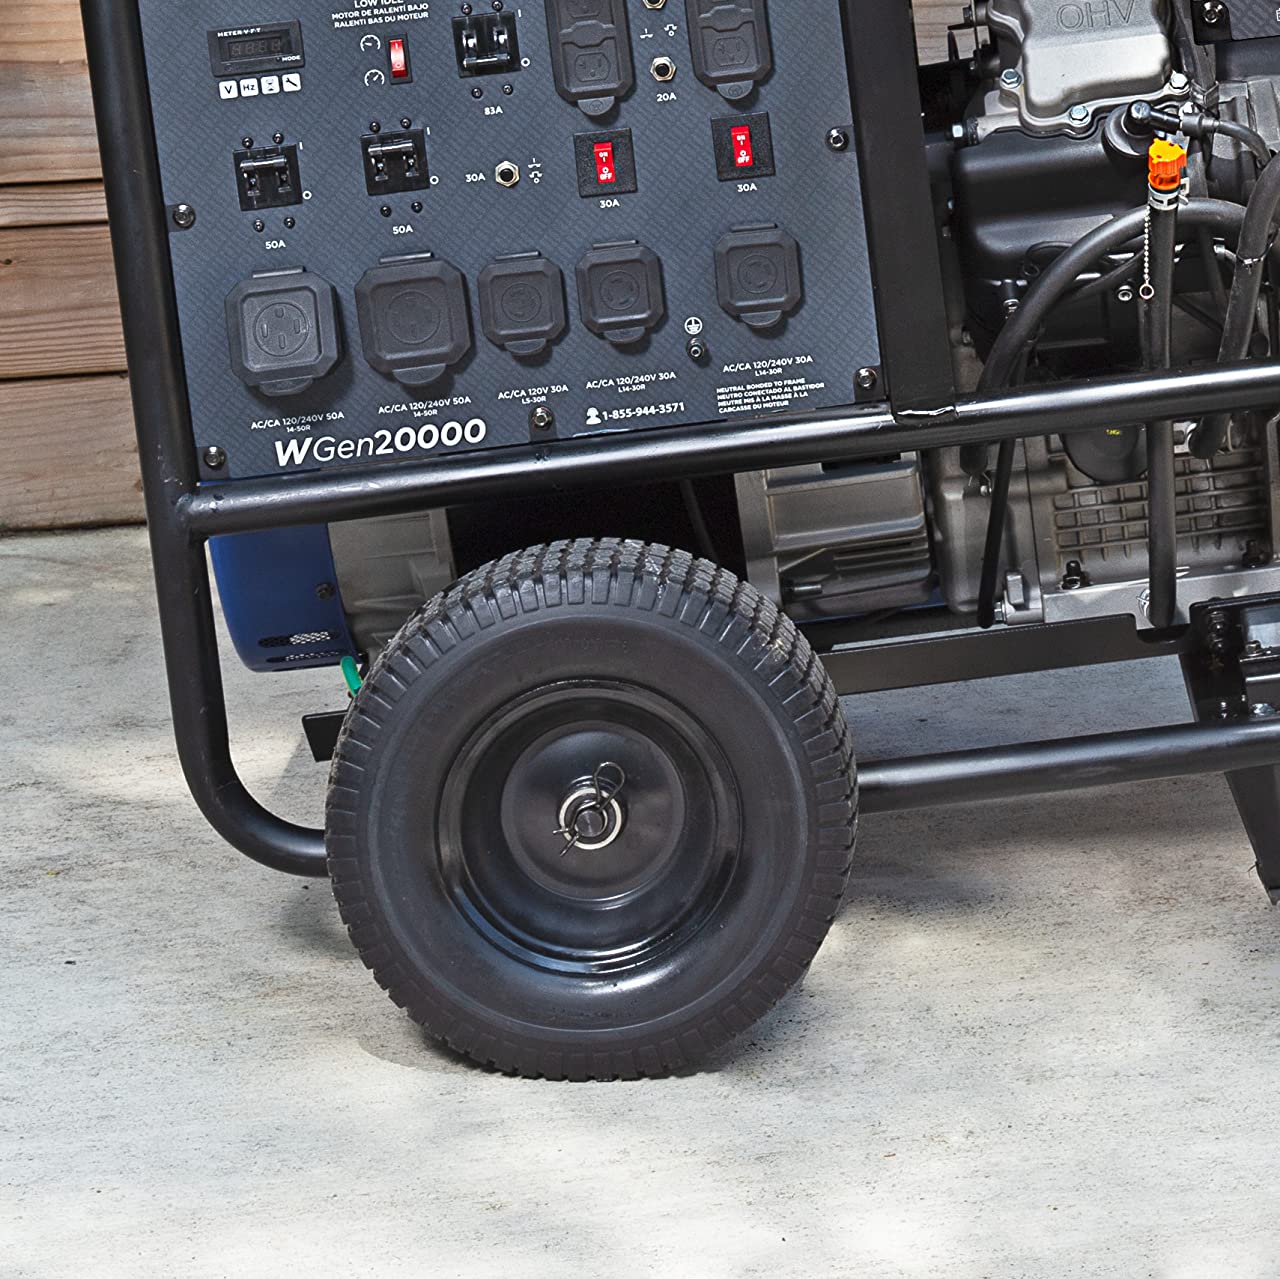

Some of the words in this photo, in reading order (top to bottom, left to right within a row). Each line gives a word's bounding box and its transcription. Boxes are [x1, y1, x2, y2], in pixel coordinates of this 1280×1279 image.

[331, 10, 360, 20] MOTOR
[407, 3, 429, 11] BAJO
[334, 18, 366, 28] RALENTI
[368, 16, 383, 24] BAS
[397, 12, 429, 20] MOTEUR
[224, 85, 232, 94] V
[656, 92, 677, 102] 20A
[484, 106, 503, 115] 83A
[737, 156, 750, 164] OFF
[465, 173, 486, 182] 30A
[737, 183, 757, 192] 30A
[600, 199, 620, 208] 30A
[392, 224, 413, 235] 50A
[265, 239, 286, 250] 50A
[723, 363, 752, 373] AC/CA
[753, 357, 793, 369] 120/240V
[795, 355, 813, 364] 30A
[755, 368, 783, 377] L14-30R
[586, 379, 614, 389] AC/CA
[616, 373, 656, 385] 120/240V
[658, 371, 676, 380] 30A
[498, 389, 527, 399] AC/CA
[528, 387, 549, 396] 120V
[550, 384, 569, 393] 30A
[618, 384, 646, 393] L14-30R
[716, 385, 745, 393] NEUTRAL
[746, 382, 773, 390] BONDED
[717, 392, 743, 400] NEUTRO
[744, 388, 782, 397] CONECTADO
[793, 383, 825, 391] BASTIDOR
[378, 403, 408, 414] AC/CA
[409, 398, 451, 411] 120/240V
[452, 395, 472, 405] 50A
[718, 399, 743, 407] NEUTRE
[771, 393, 792, 401] MASSE
[602, 401, 685, 421] 1-855-944-3571
[718, 404, 752, 414] CARCASSE
[763, 400, 789, 408] MOTEUR
[413, 409, 438, 418] 14-50R
[251, 419, 281, 430] AC/CA
[282, 413, 324, 426] 120/240V
[326, 411, 345, 421] 50A
[286, 424, 311, 433] 14-50R
[274, 418, 487, 467] WGen20000
